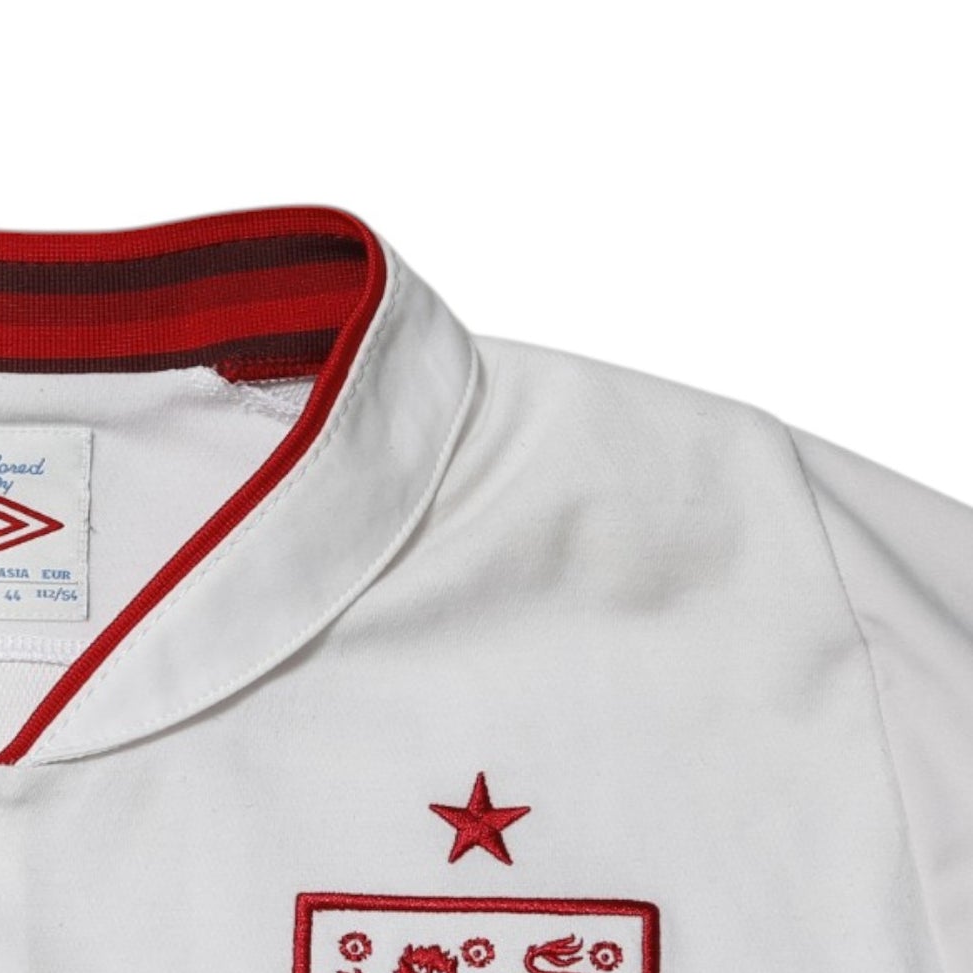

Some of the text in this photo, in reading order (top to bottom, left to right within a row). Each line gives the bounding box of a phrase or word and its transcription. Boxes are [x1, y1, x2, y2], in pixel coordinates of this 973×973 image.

[41, 568, 71, 580] EUR
[4, 589, 21, 601] 44
[36, 588, 78, 602] 112/54
